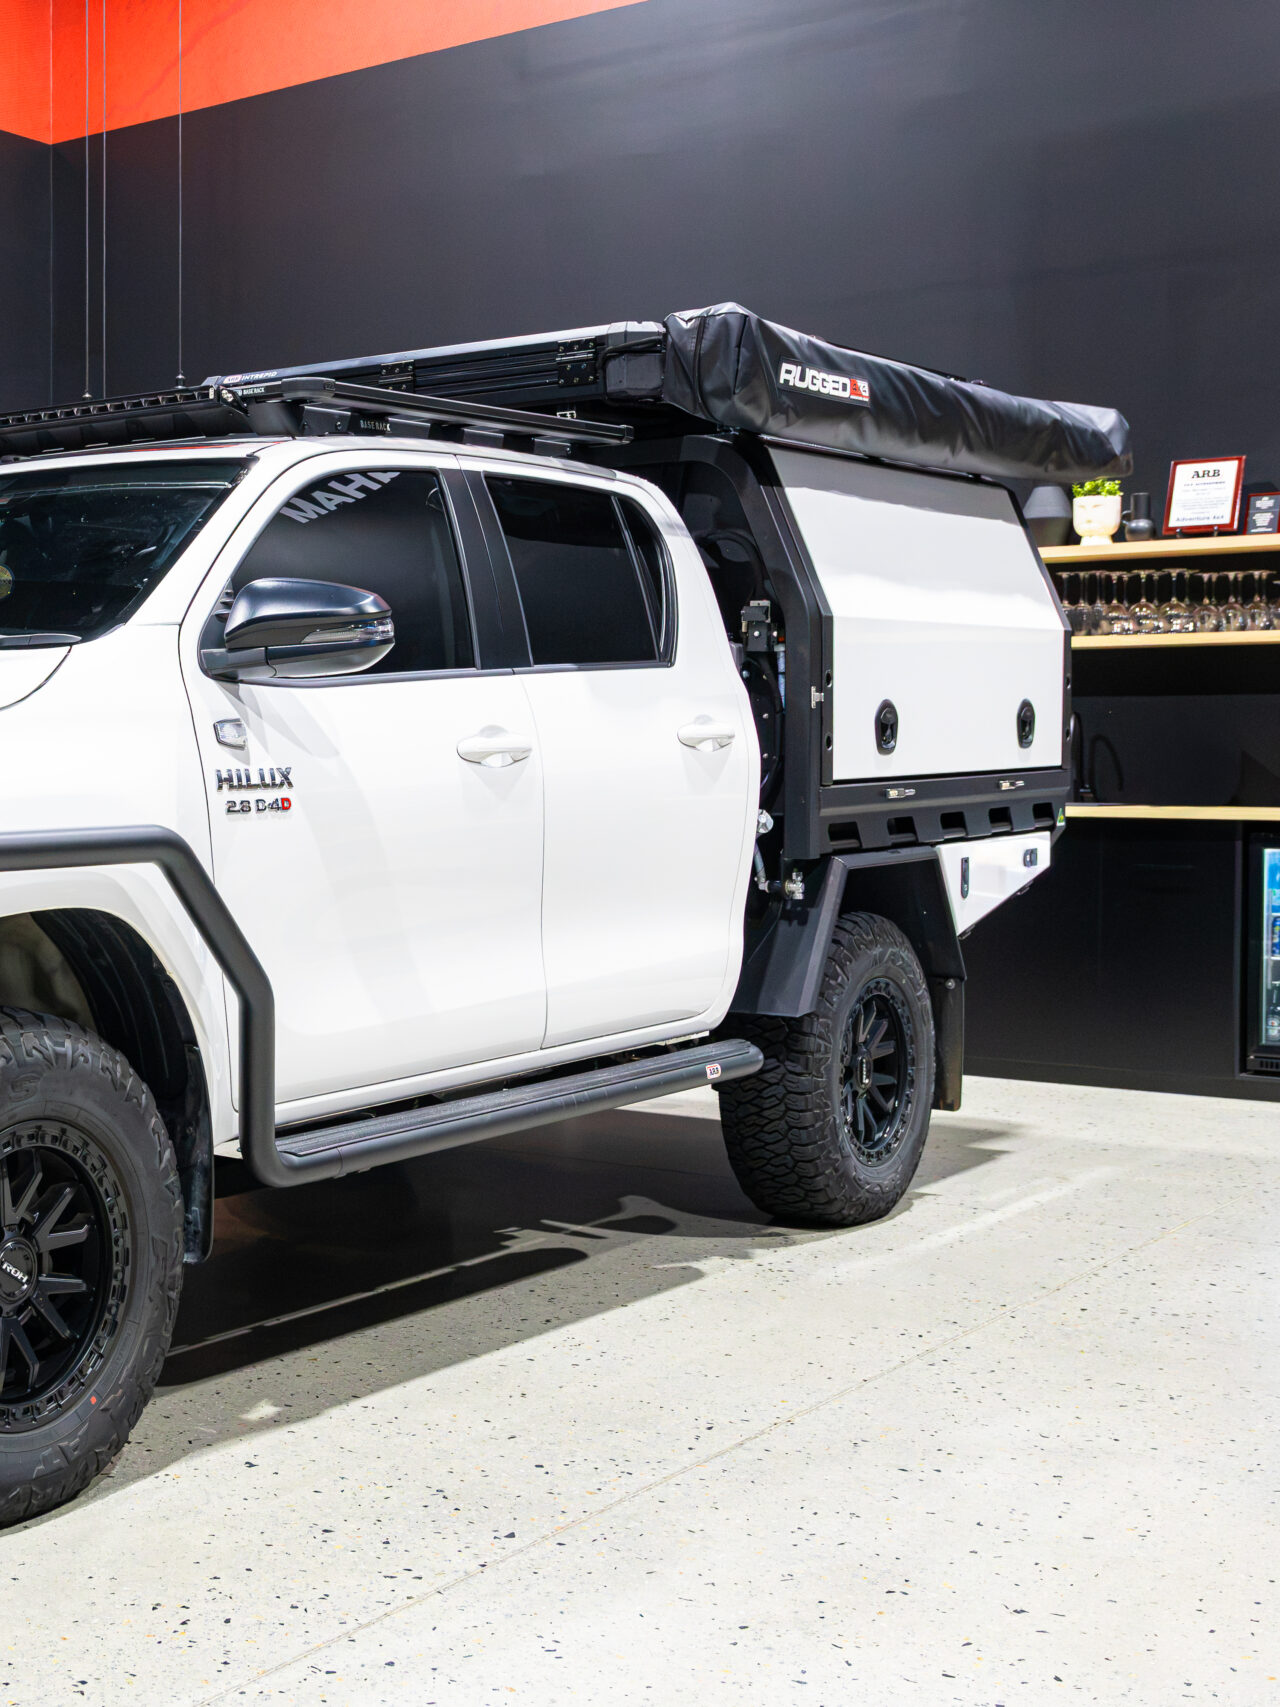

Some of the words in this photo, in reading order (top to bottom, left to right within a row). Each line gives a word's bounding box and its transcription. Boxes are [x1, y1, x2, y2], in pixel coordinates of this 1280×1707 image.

[241, 371, 278, 381] INTREPID
[780, 362, 851, 398] RUGGED
[1192, 469, 1221, 479] ARB
[216, 766, 294, 791] HILUX
[1, 1261, 29, 1283] ROH
